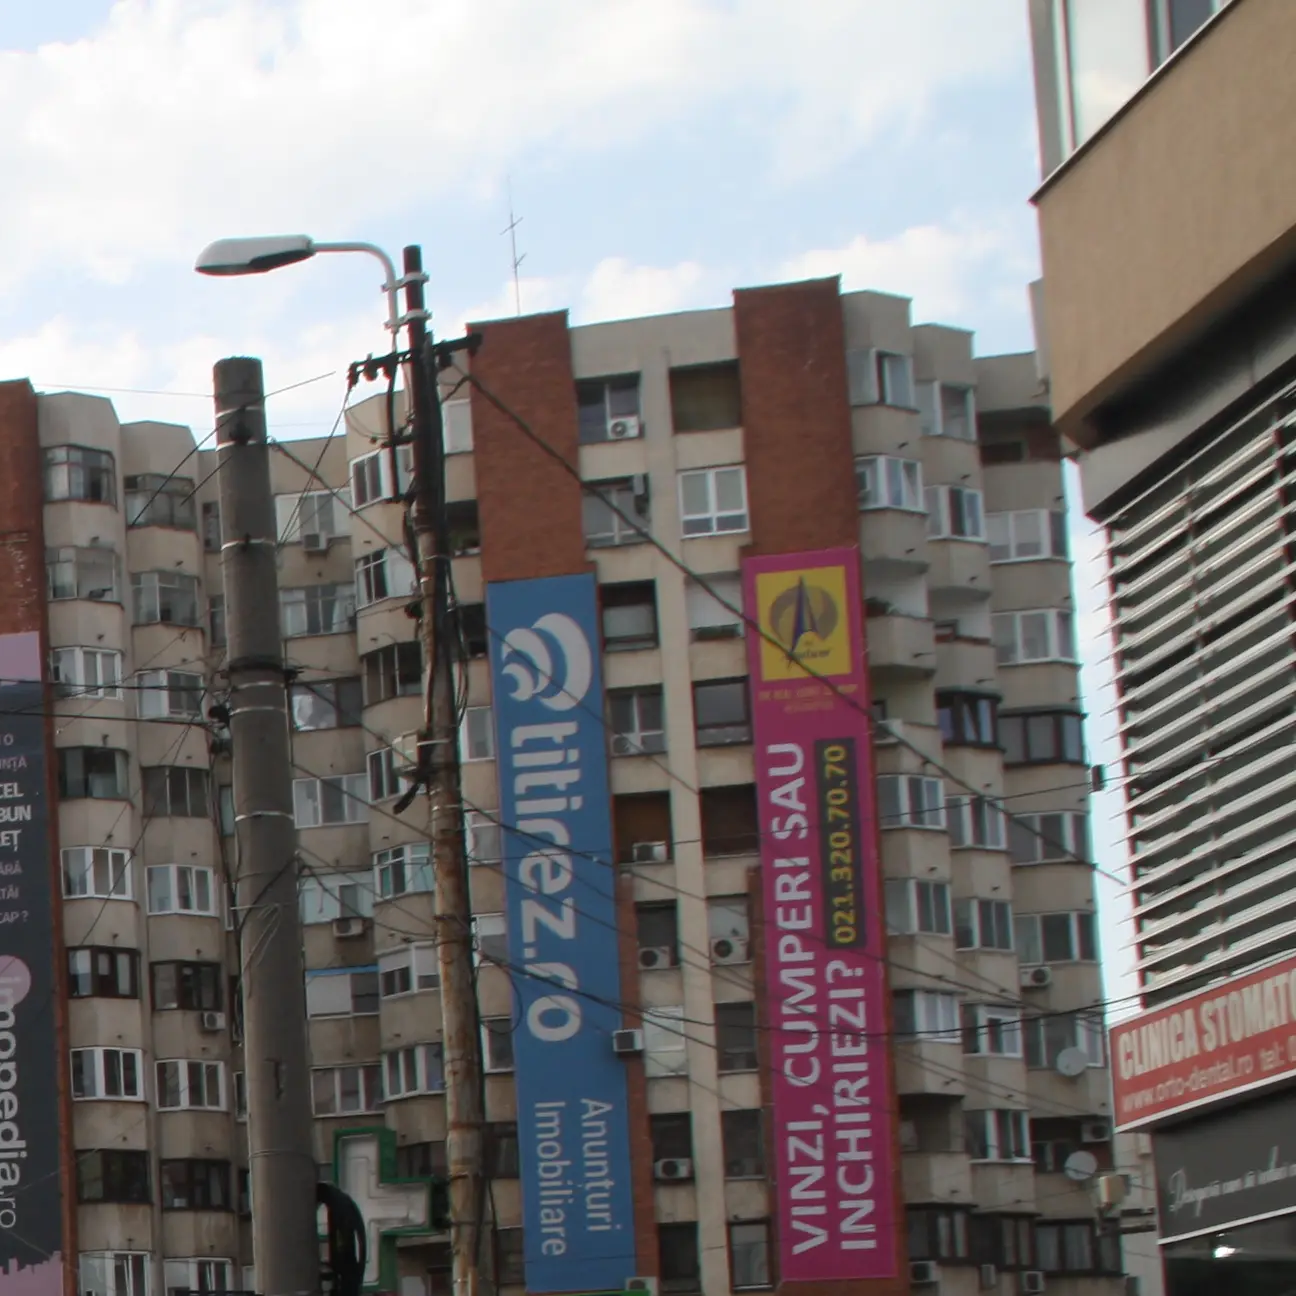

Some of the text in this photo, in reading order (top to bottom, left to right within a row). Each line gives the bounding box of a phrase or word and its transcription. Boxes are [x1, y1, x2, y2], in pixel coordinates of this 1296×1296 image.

[4, 733, 14, 746] O
[766, 742, 808, 840] SAU
[510, 721, 583, 1041] titirez.ro
[824, 744, 857, 944] 021.320.70.70
[773, 857, 821, 1087] CUMPERI
[1118, 1008, 1200, 1080] CLINICA
[534, 1101, 573, 1256] Imobiliare
[786, 1103, 829, 1255] VINZI,
[825, 960, 877, 1250] INCHIRIEZI?
